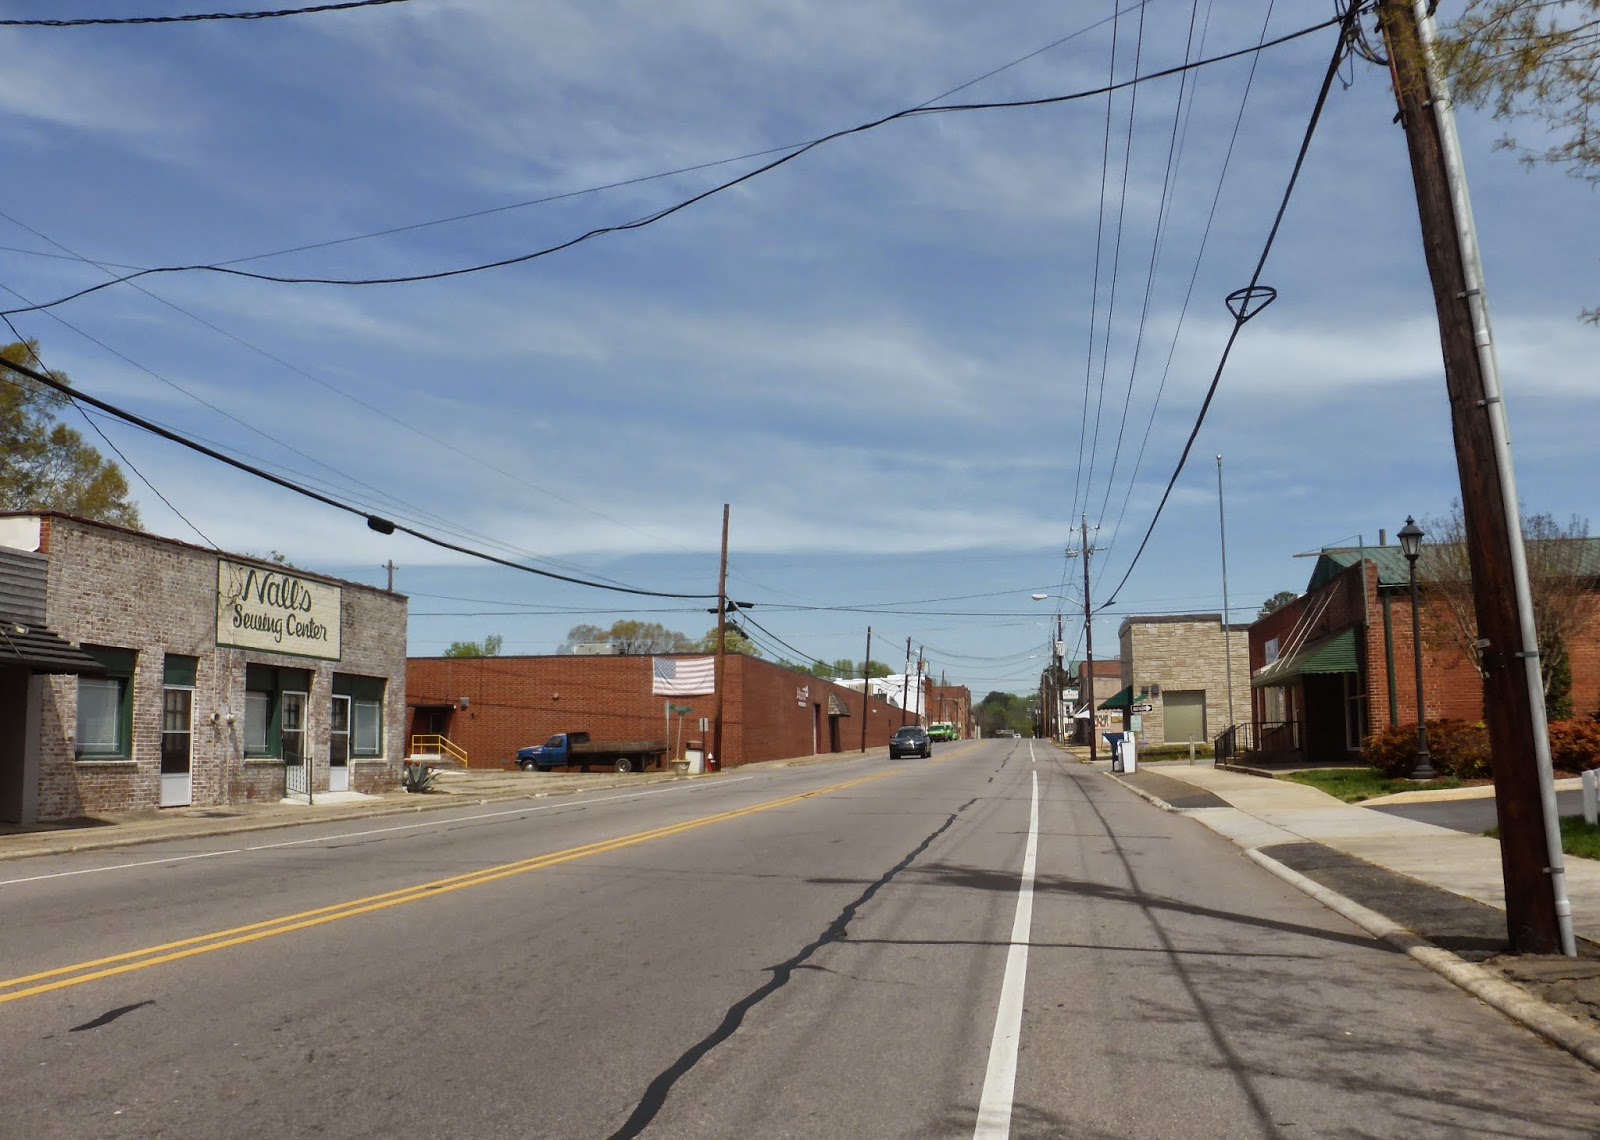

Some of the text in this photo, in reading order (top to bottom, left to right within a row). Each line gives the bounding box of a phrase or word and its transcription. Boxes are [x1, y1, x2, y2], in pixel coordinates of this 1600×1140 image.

[241, 569, 312, 612] Nall's
[233, 603, 328, 643] Sewing Center
